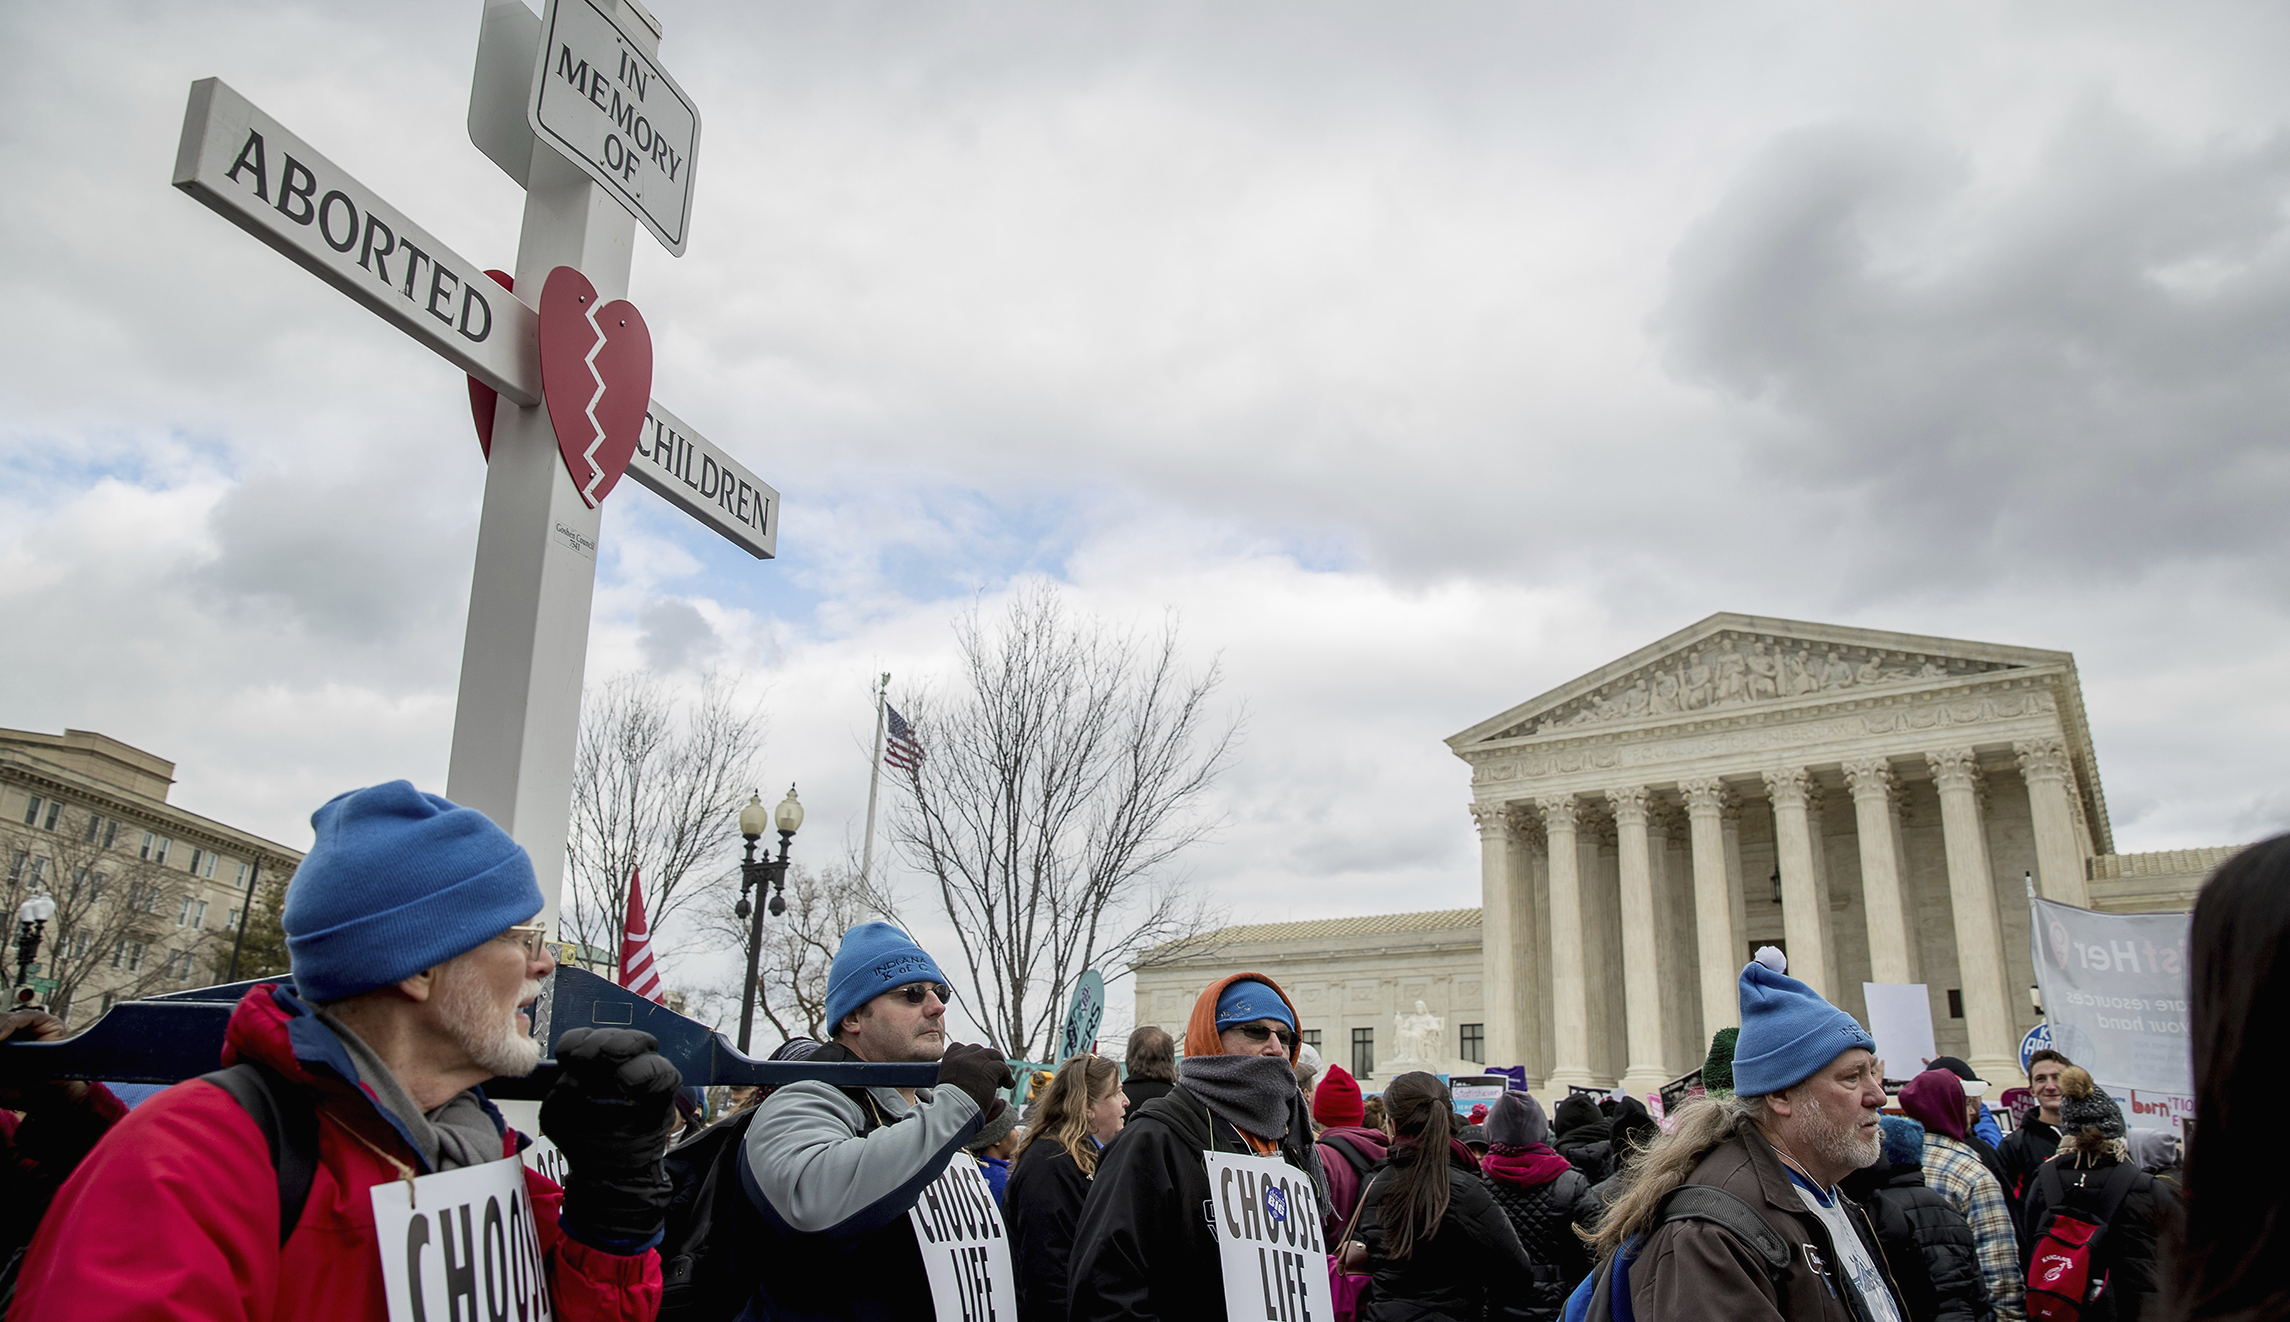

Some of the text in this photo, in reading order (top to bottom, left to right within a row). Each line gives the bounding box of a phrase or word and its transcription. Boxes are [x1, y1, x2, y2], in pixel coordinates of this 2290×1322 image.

[556, 42, 683, 184] MEMORY
[617, 48, 649, 103] IN
[604, 133, 641, 184] OF
[224, 127, 492, 343] ABORTED
[636, 411, 770, 536] CHILDREN
[874, 956, 928, 977] INDIANA
[881, 970, 894, 981] K
[918, 963, 928, 972] C
[915, 1165, 1001, 1244] CHOOSE
[1220, 1167, 1321, 1254] CHOOSE
[1268, 1194, 1285, 1217] BIG
[950, 1246, 997, 1322] LIFE
[1258, 1247, 1312, 1322] LIFE
